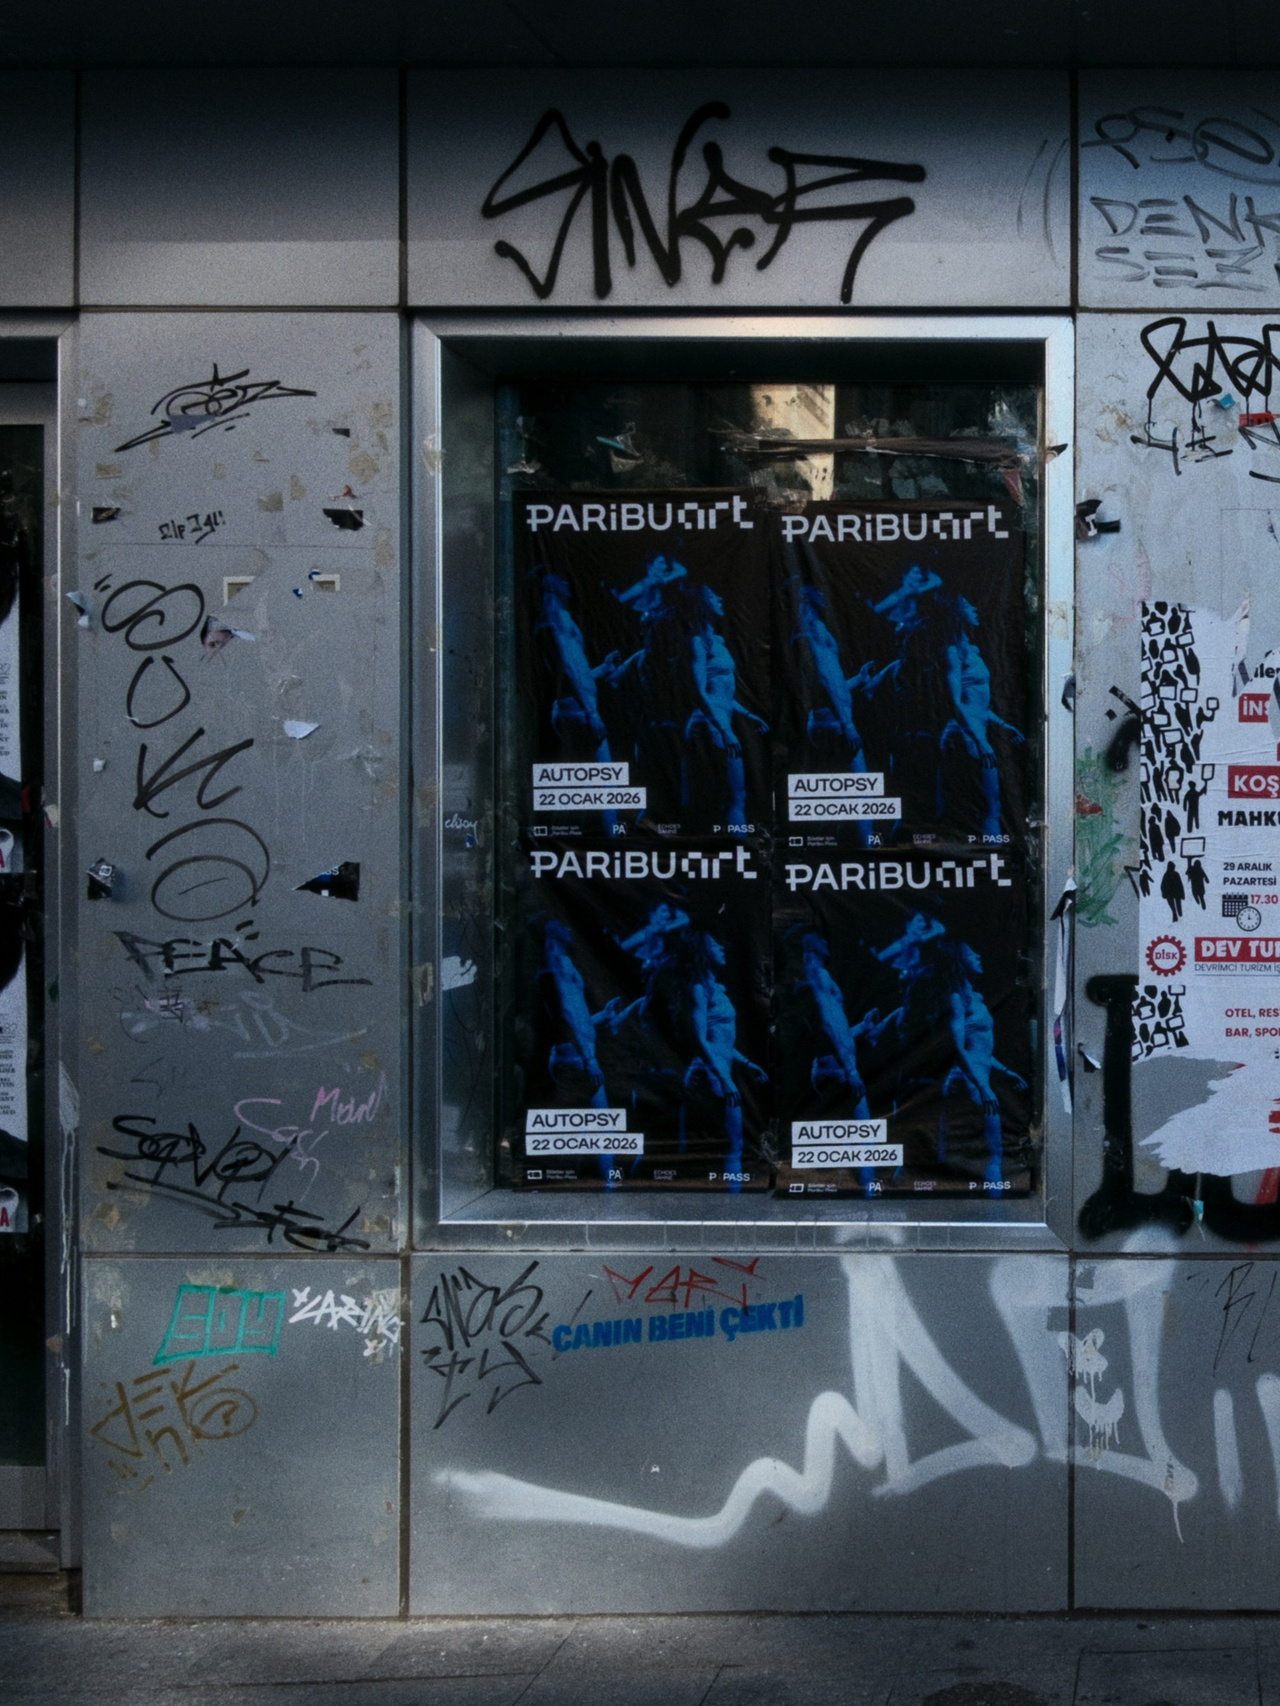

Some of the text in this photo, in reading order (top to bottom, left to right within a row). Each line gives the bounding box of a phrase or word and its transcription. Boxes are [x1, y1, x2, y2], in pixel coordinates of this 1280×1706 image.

[538, 767, 623, 782] AUTOPSY
[793, 778, 878, 793] AUTOPSY
[539, 792, 641, 806] 22 OCAK 2026
[794, 802, 896, 816] 22 OCAK 2026
[727, 824, 755, 833] PASS
[982, 834, 1010, 843] PASS
[1223, 862, 1272, 871] 29 ARALIK
[1223, 875, 1277, 886] PAZARTESİ
[1250, 894, 1279, 905] 17.30
[1201, 940, 1242, 958] DEV
[1225, 1008, 1255, 1018] OTEL,
[1225, 1028, 1252, 1038] BAR,
[532, 1113, 621, 1128] AUTOPSY
[797, 1124, 881, 1140] AUTOPSY
[532, 1138, 638, 1151] 22 OCAK 2026
[797, 1149, 898, 1163] 22 OCAK 2026
[722, 1172, 751, 1182] PASS
[983, 1181, 1011, 1190] PASS
[552, 1295, 804, 1353] CANIN BENİ ÇEKTİ
